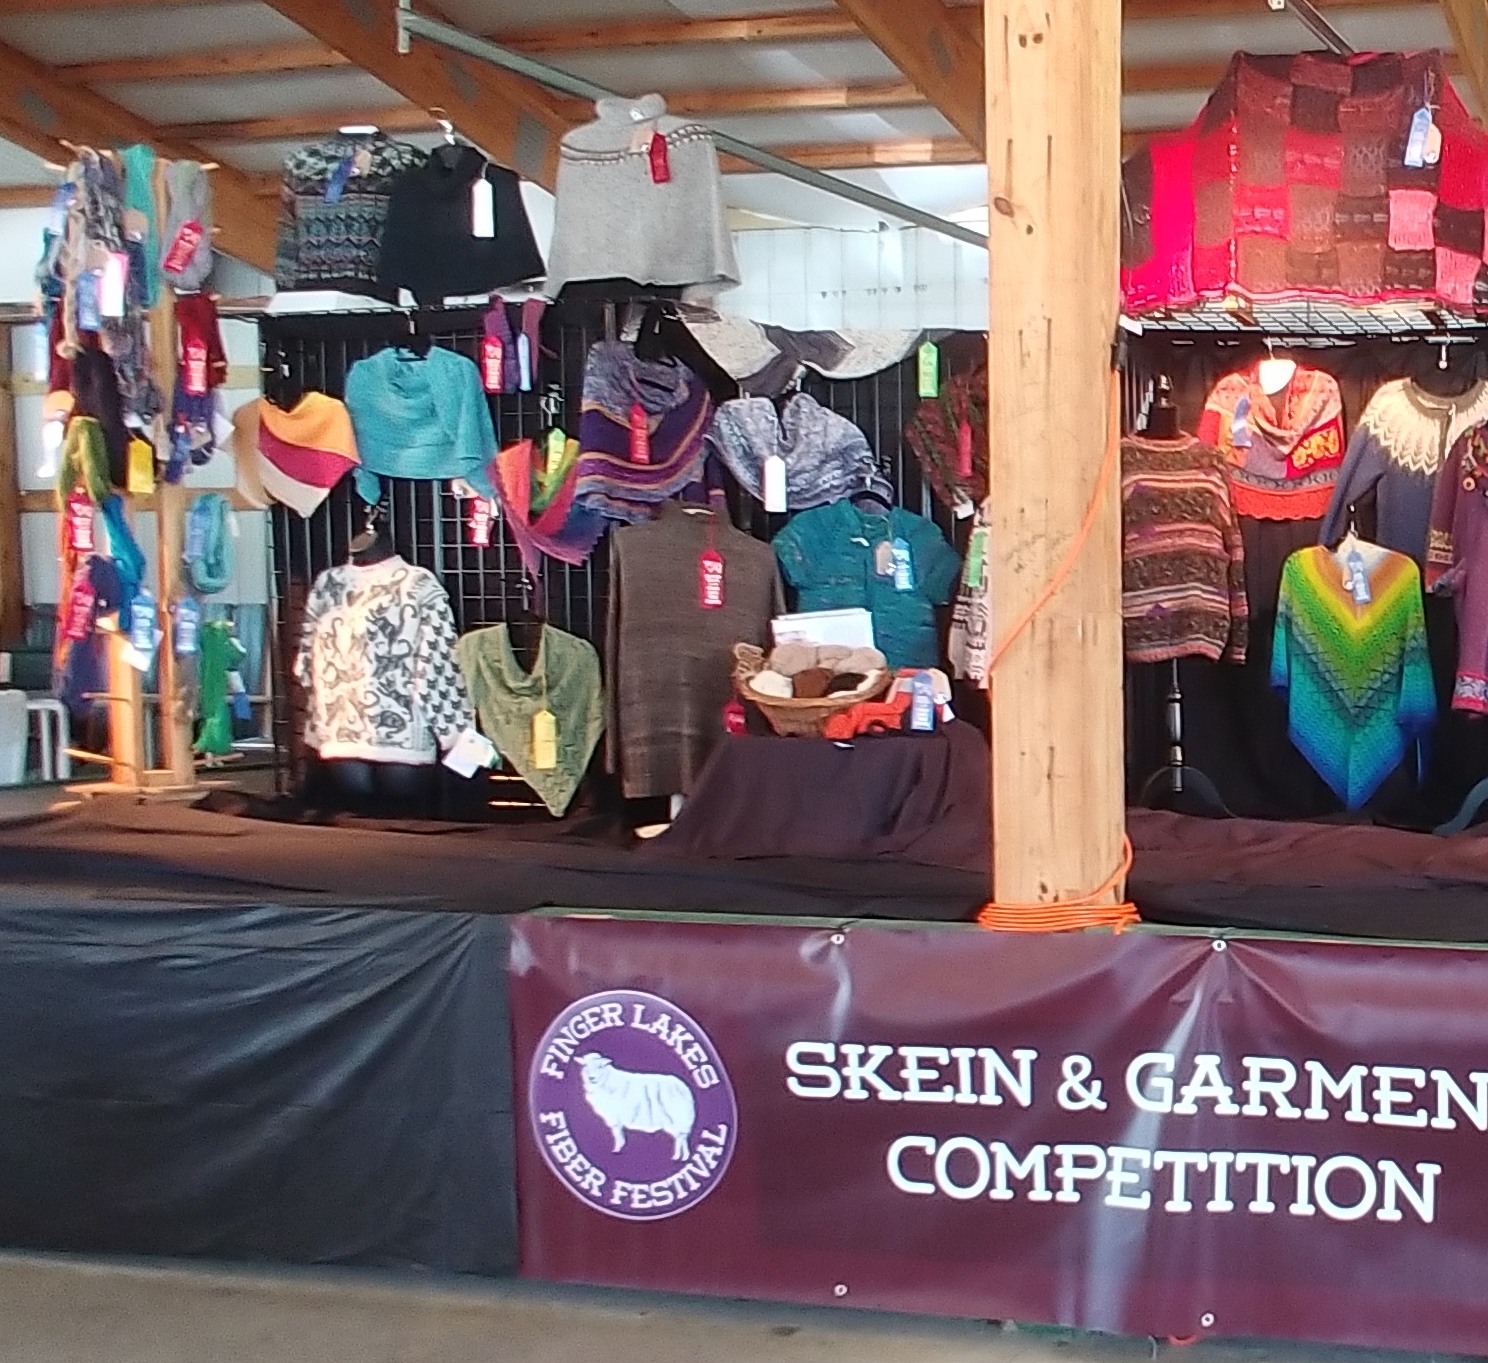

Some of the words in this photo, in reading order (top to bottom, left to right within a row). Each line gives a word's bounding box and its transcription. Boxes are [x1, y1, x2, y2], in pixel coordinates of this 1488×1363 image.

[540, 1002, 625, 1080] FINGER
[631, 1003, 720, 1089] LAKES
[786, 1041, 1038, 1107] SKEIN
[1057, 1054, 1107, 1111] &
[539, 1110, 606, 1197] FIBER
[610, 1123, 728, 1209] FESTIVAL
[887, 1135, 1442, 1223] COMPETITION
